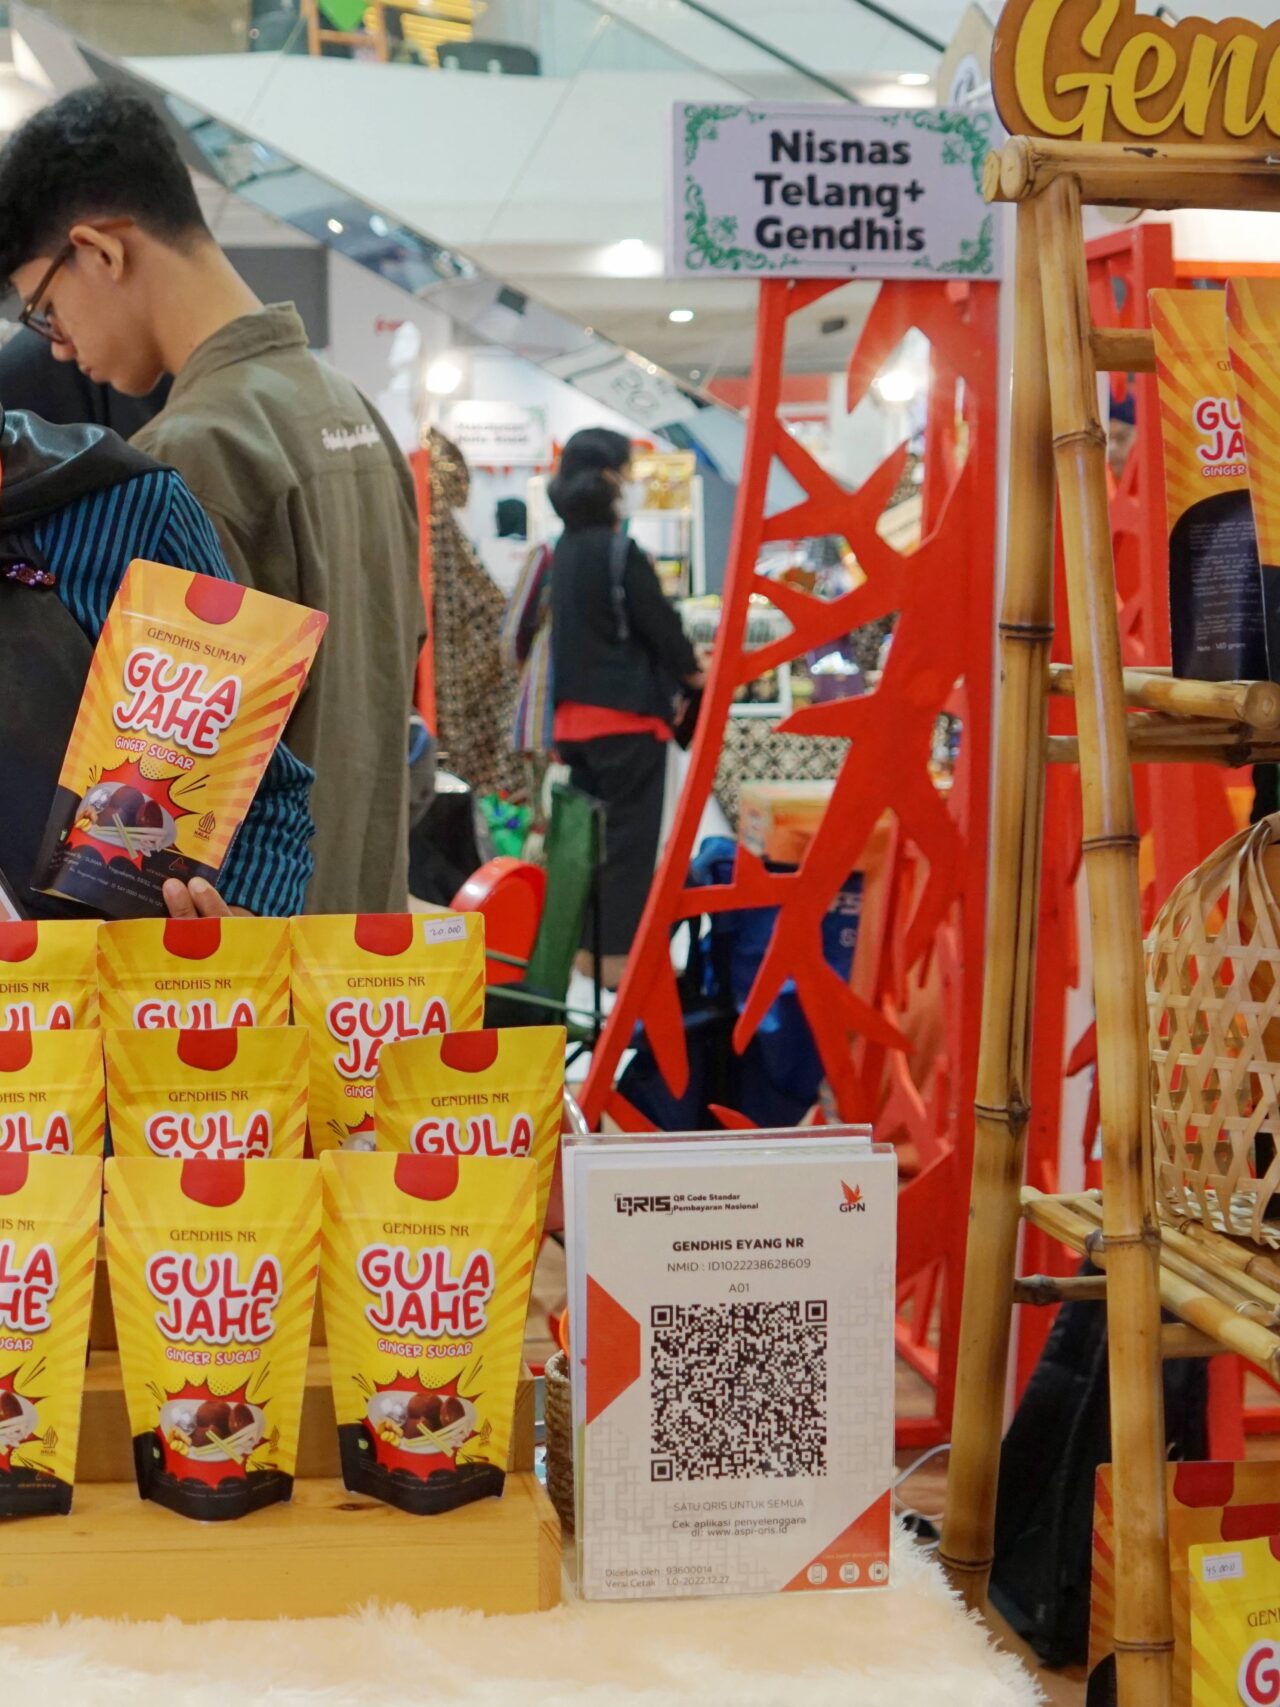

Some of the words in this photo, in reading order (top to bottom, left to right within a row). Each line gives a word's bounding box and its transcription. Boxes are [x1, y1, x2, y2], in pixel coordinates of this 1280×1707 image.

[1015, 0, 1280, 144] Gen
[770, 129, 911, 164] Nisnas
[754, 173, 925, 218] Telang+
[755, 216, 926, 251] Gendhis
[1202, 465, 1246, 477] GINGER
[147, 627, 202, 653] GENDHIS
[203, 643, 247, 666] SUMAN
[126, 651, 238, 716] GULA
[116, 690, 227, 750] JAHE
[115, 736, 146, 752] GINGER
[149, 743, 195, 771] SUGAR
[32, 982, 50, 993] NR
[154, 979, 211, 990] GENDHIS
[214, 979, 232, 989] NR
[347, 976, 404, 988] GENDHIS
[408, 976, 426, 986] NR
[329, 1000, 447, 1038] GULA
[29, 1091, 47, 1102] NR
[168, 1091, 228, 1102] GENDHIS
[231, 1090, 249, 1100] NR
[344, 1085, 376, 1098] GING
[431, 1094, 488, 1107] GENDHIS
[492, 1093, 510, 1103] NR
[148, 1113, 270, 1150] GULA
[414, 1117, 532, 1156] GULA
[687, 1194, 707, 1202] Code
[709, 1193, 741, 1201] Standar
[673, 1204, 723, 1213] Pembayaran
[725, 1203, 759, 1211] Nasional
[839, 1202, 866, 1213] GPN
[17, 1219, 35, 1231] NR
[382, 1222, 446, 1236] GENDHIS
[450, 1225, 470, 1237] NR
[170, 1229, 233, 1242] GENDHIS
[237, 1231, 257, 1242] NR
[672, 1240, 733, 1252] GENDHIS
[736, 1238, 782, 1250] EYANG
[786, 1237, 805, 1249] NR
[361, 1248, 490, 1292] GULA
[667, 1262, 700, 1272] NMID
[150, 1256, 278, 1298] GULA
[728, 1283, 750, 1293] A01
[159, 1297, 273, 1338] JAHE
[369, 1290, 486, 1331] JAHE
[166, 1347, 211, 1365] GINGER
[215, 1348, 261, 1365] SUGAR
[377, 1338, 422, 1358] GINGER
[426, 1341, 473, 1359] SUGAR
[673, 1503, 700, 1512] SATU
[703, 1501, 728, 1511] QRIS
[729, 1500, 765, 1510] UNTUK
[767, 1499, 805, 1508] SEMUA
[672, 1520, 690, 1529] Cek
[694, 1519, 731, 1529] aplikasi
[734, 1517, 807, 1527] penyelenggara
[641, 1568, 660, 1576] oleh
[1247, 1607, 1280, 1628] GEN
